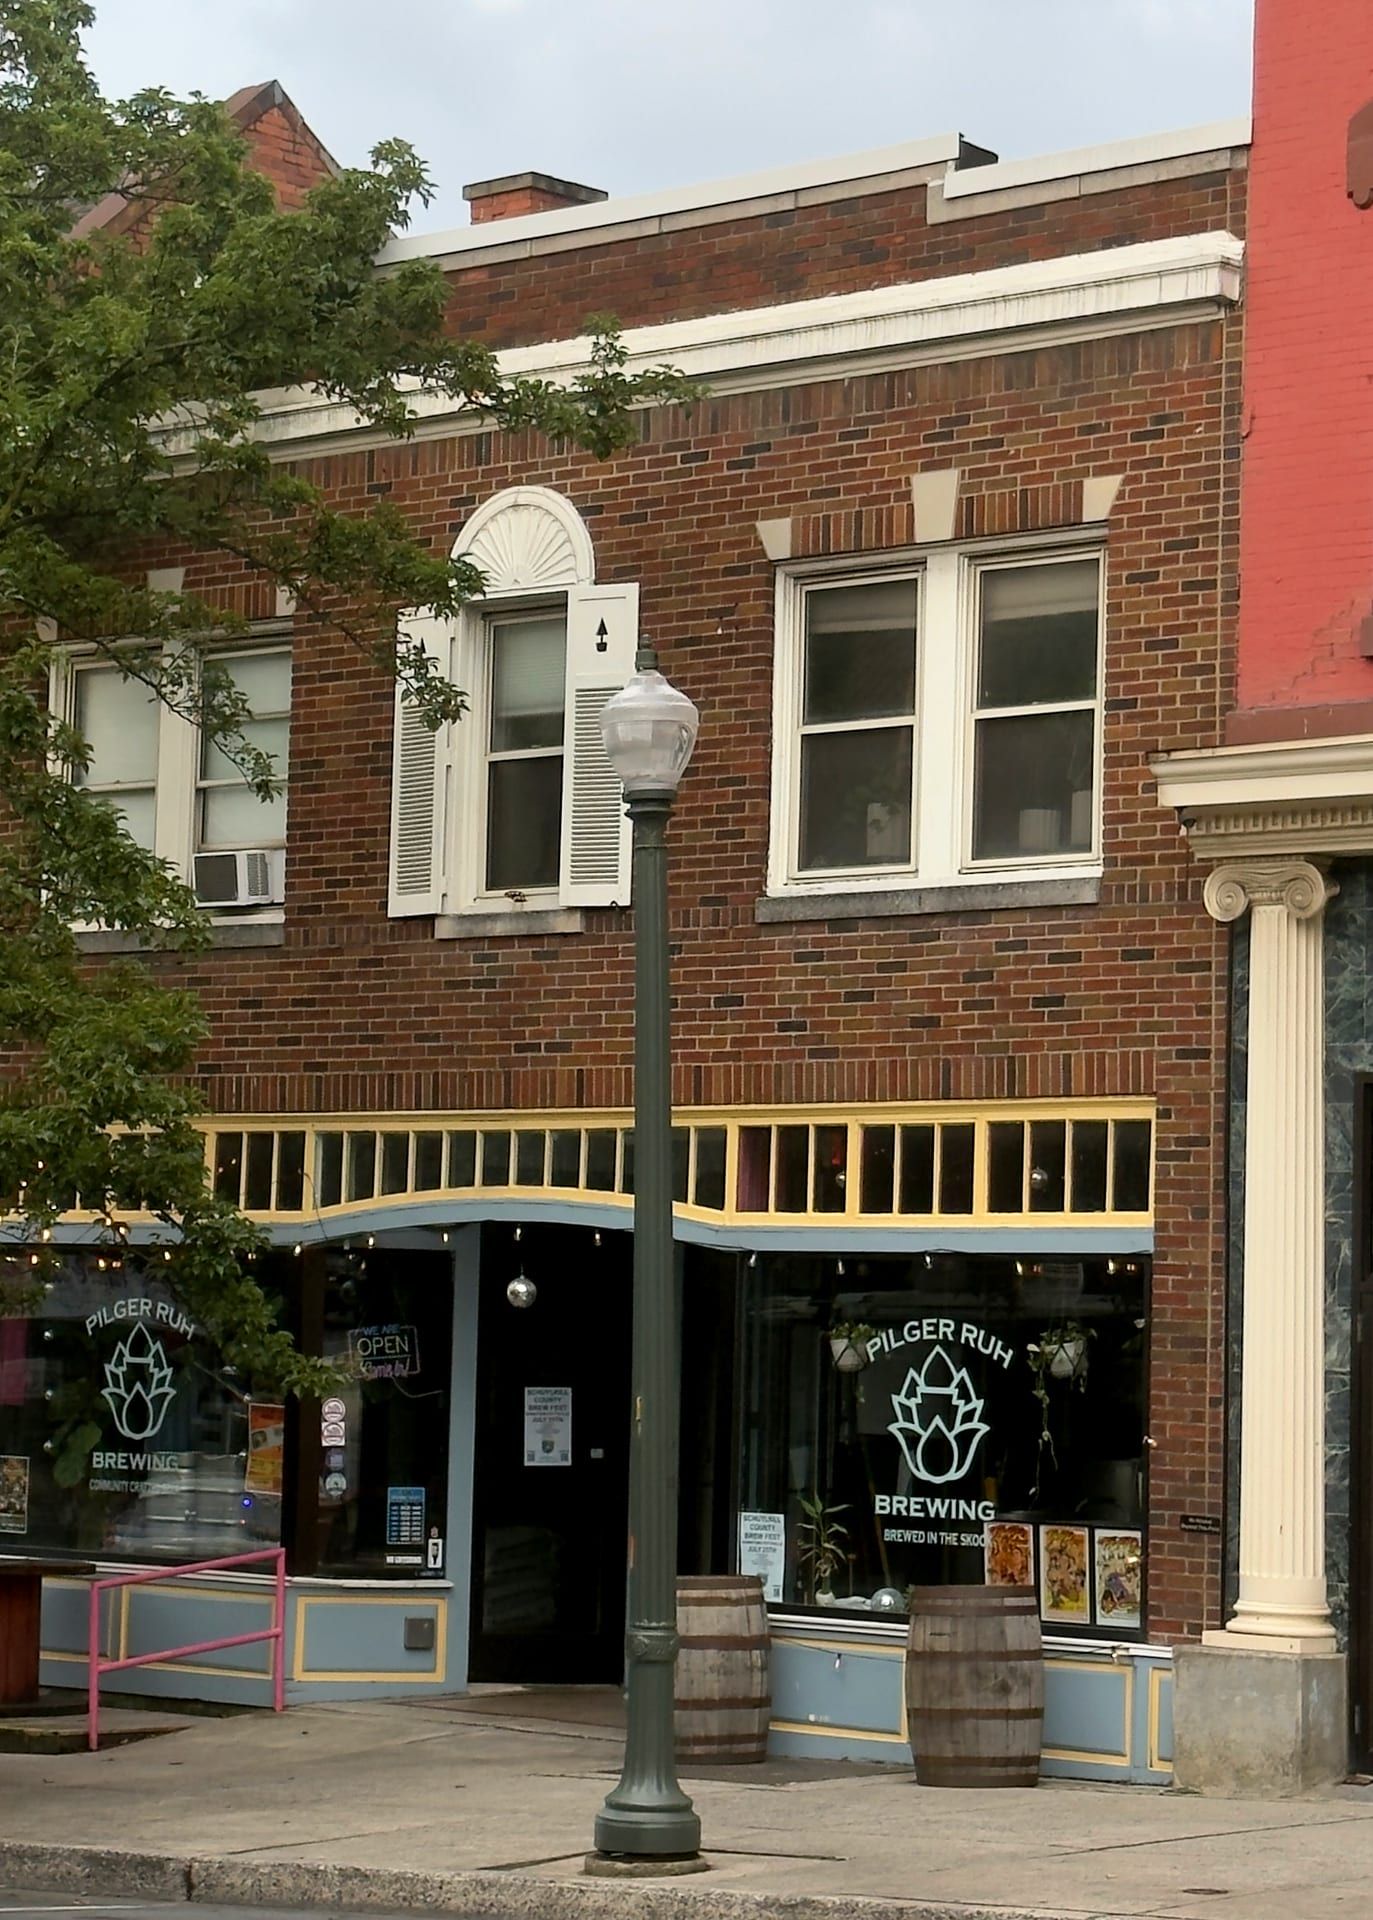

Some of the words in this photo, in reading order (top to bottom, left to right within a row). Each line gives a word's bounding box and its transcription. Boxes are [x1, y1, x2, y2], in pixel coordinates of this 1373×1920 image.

[85, 1298, 152, 1336] PILGER
[156, 1301, 195, 1340] RUH
[363, 1326, 380, 1336] WE
[356, 1334, 409, 1356] OPEN
[865, 1318, 955, 1362] PILGER
[960, 1322, 1014, 1369] RUH
[92, 1452, 179, 1472] BREWING
[89, 1479, 129, 1493] COMMUNITY
[874, 1494, 996, 1521] BREWING
[749, 1523, 776, 1531] COUNTY
[883, 1528, 926, 1544] BREWED
[927, 1530, 938, 1545] IN
[939, 1531, 959, 1547] THE
